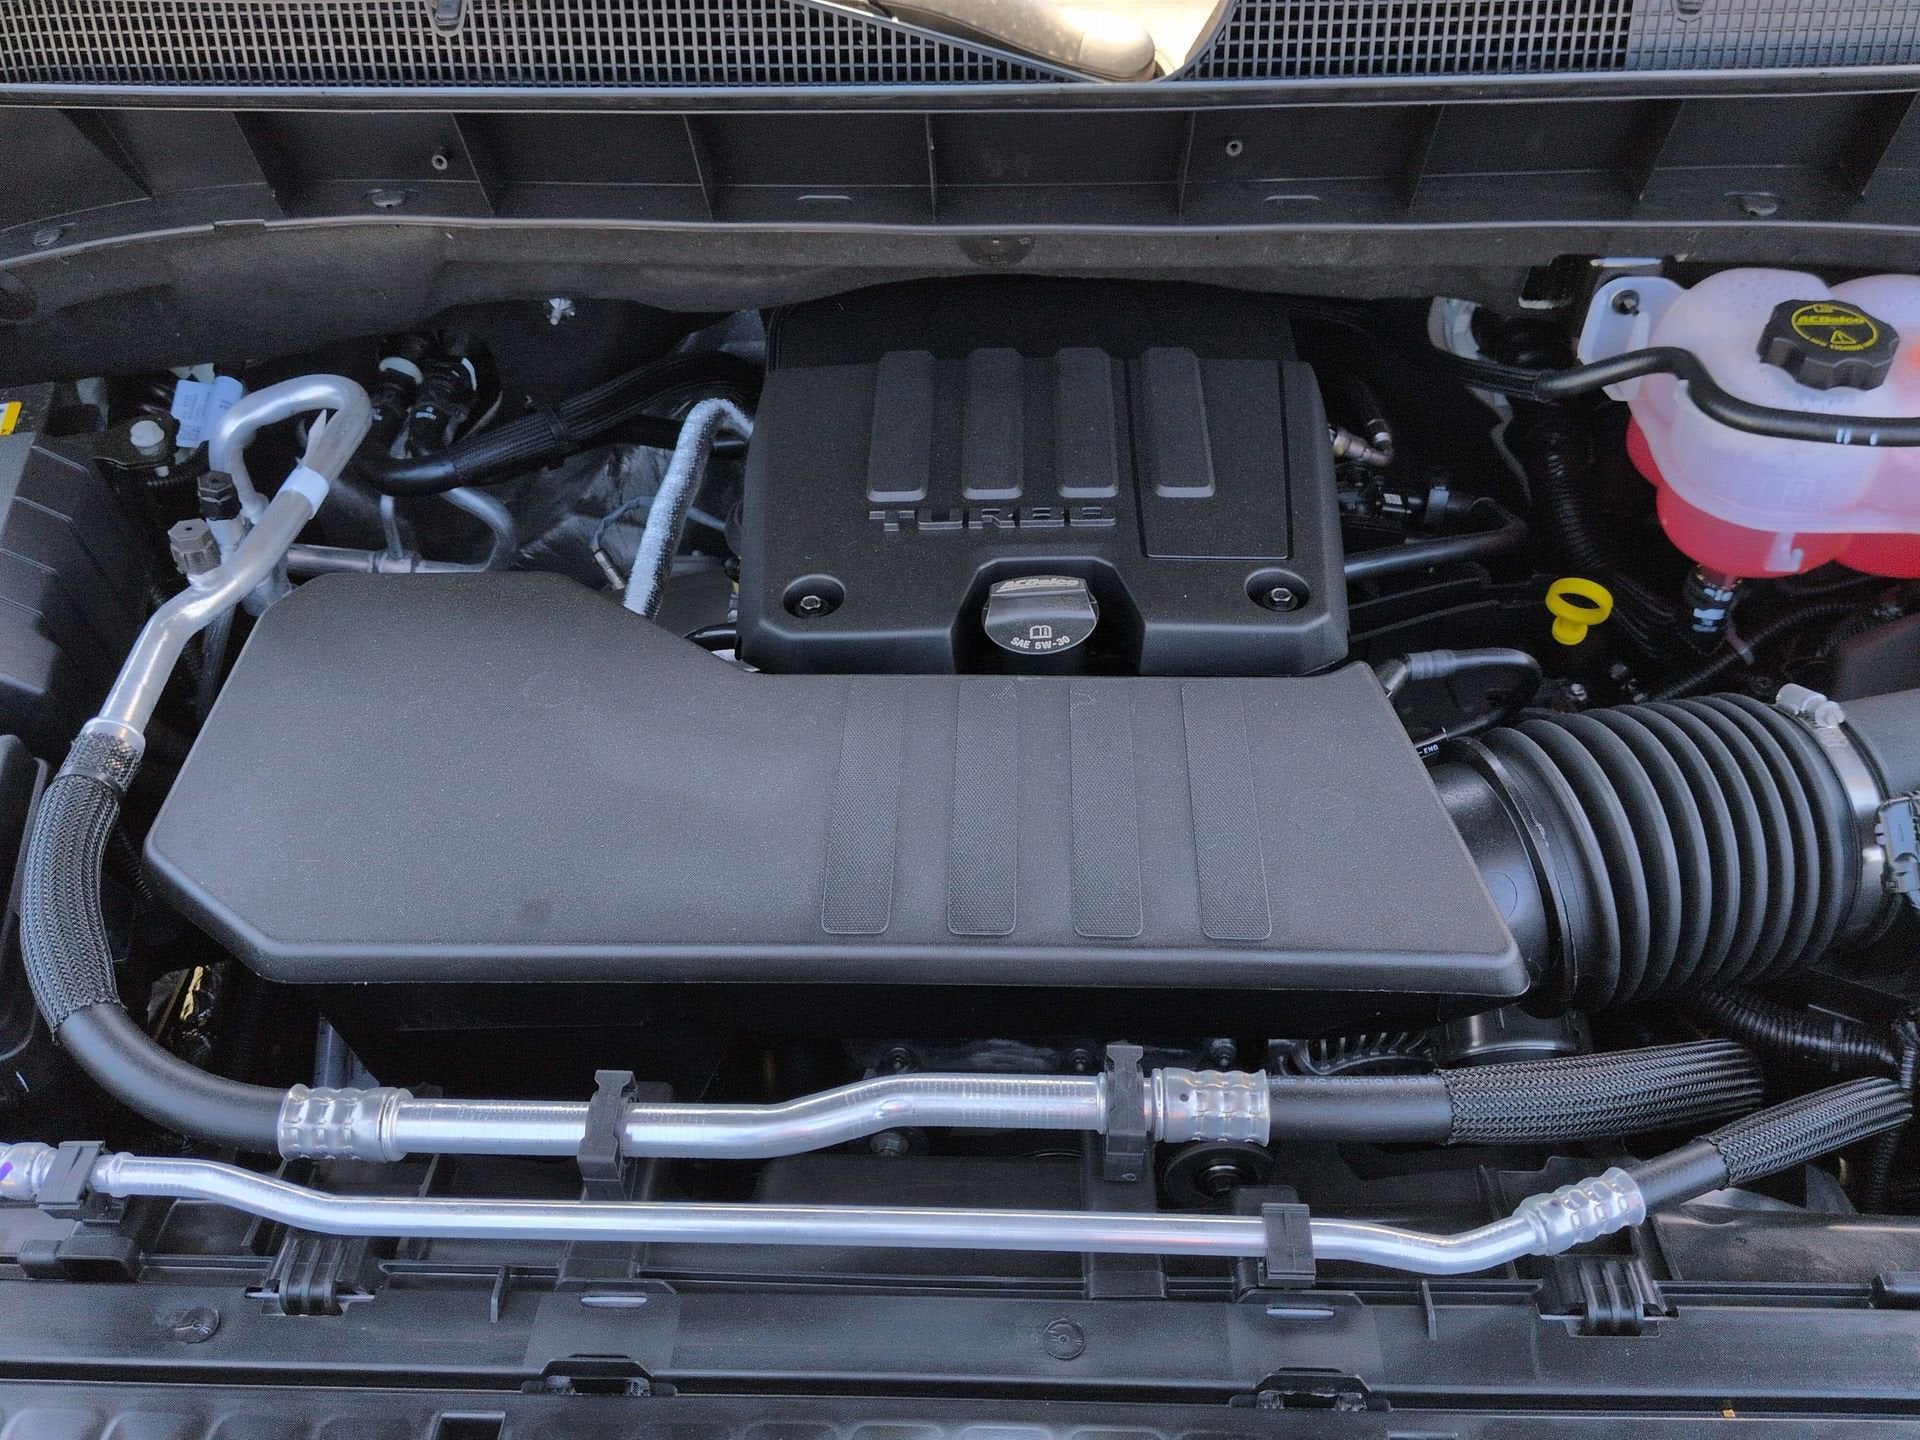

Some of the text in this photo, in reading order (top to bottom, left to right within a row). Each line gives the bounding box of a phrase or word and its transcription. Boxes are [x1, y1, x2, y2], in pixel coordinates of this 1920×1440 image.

[868, 506, 1116, 532] TURBO
[996, 577, 1080, 593] ACDelco
[1010, 635, 1071, 650] SAE 5W-30
[1330, 1077, 1394, 1086] SUCTION
[1397, 1076, 1438, 1086] HOSE
